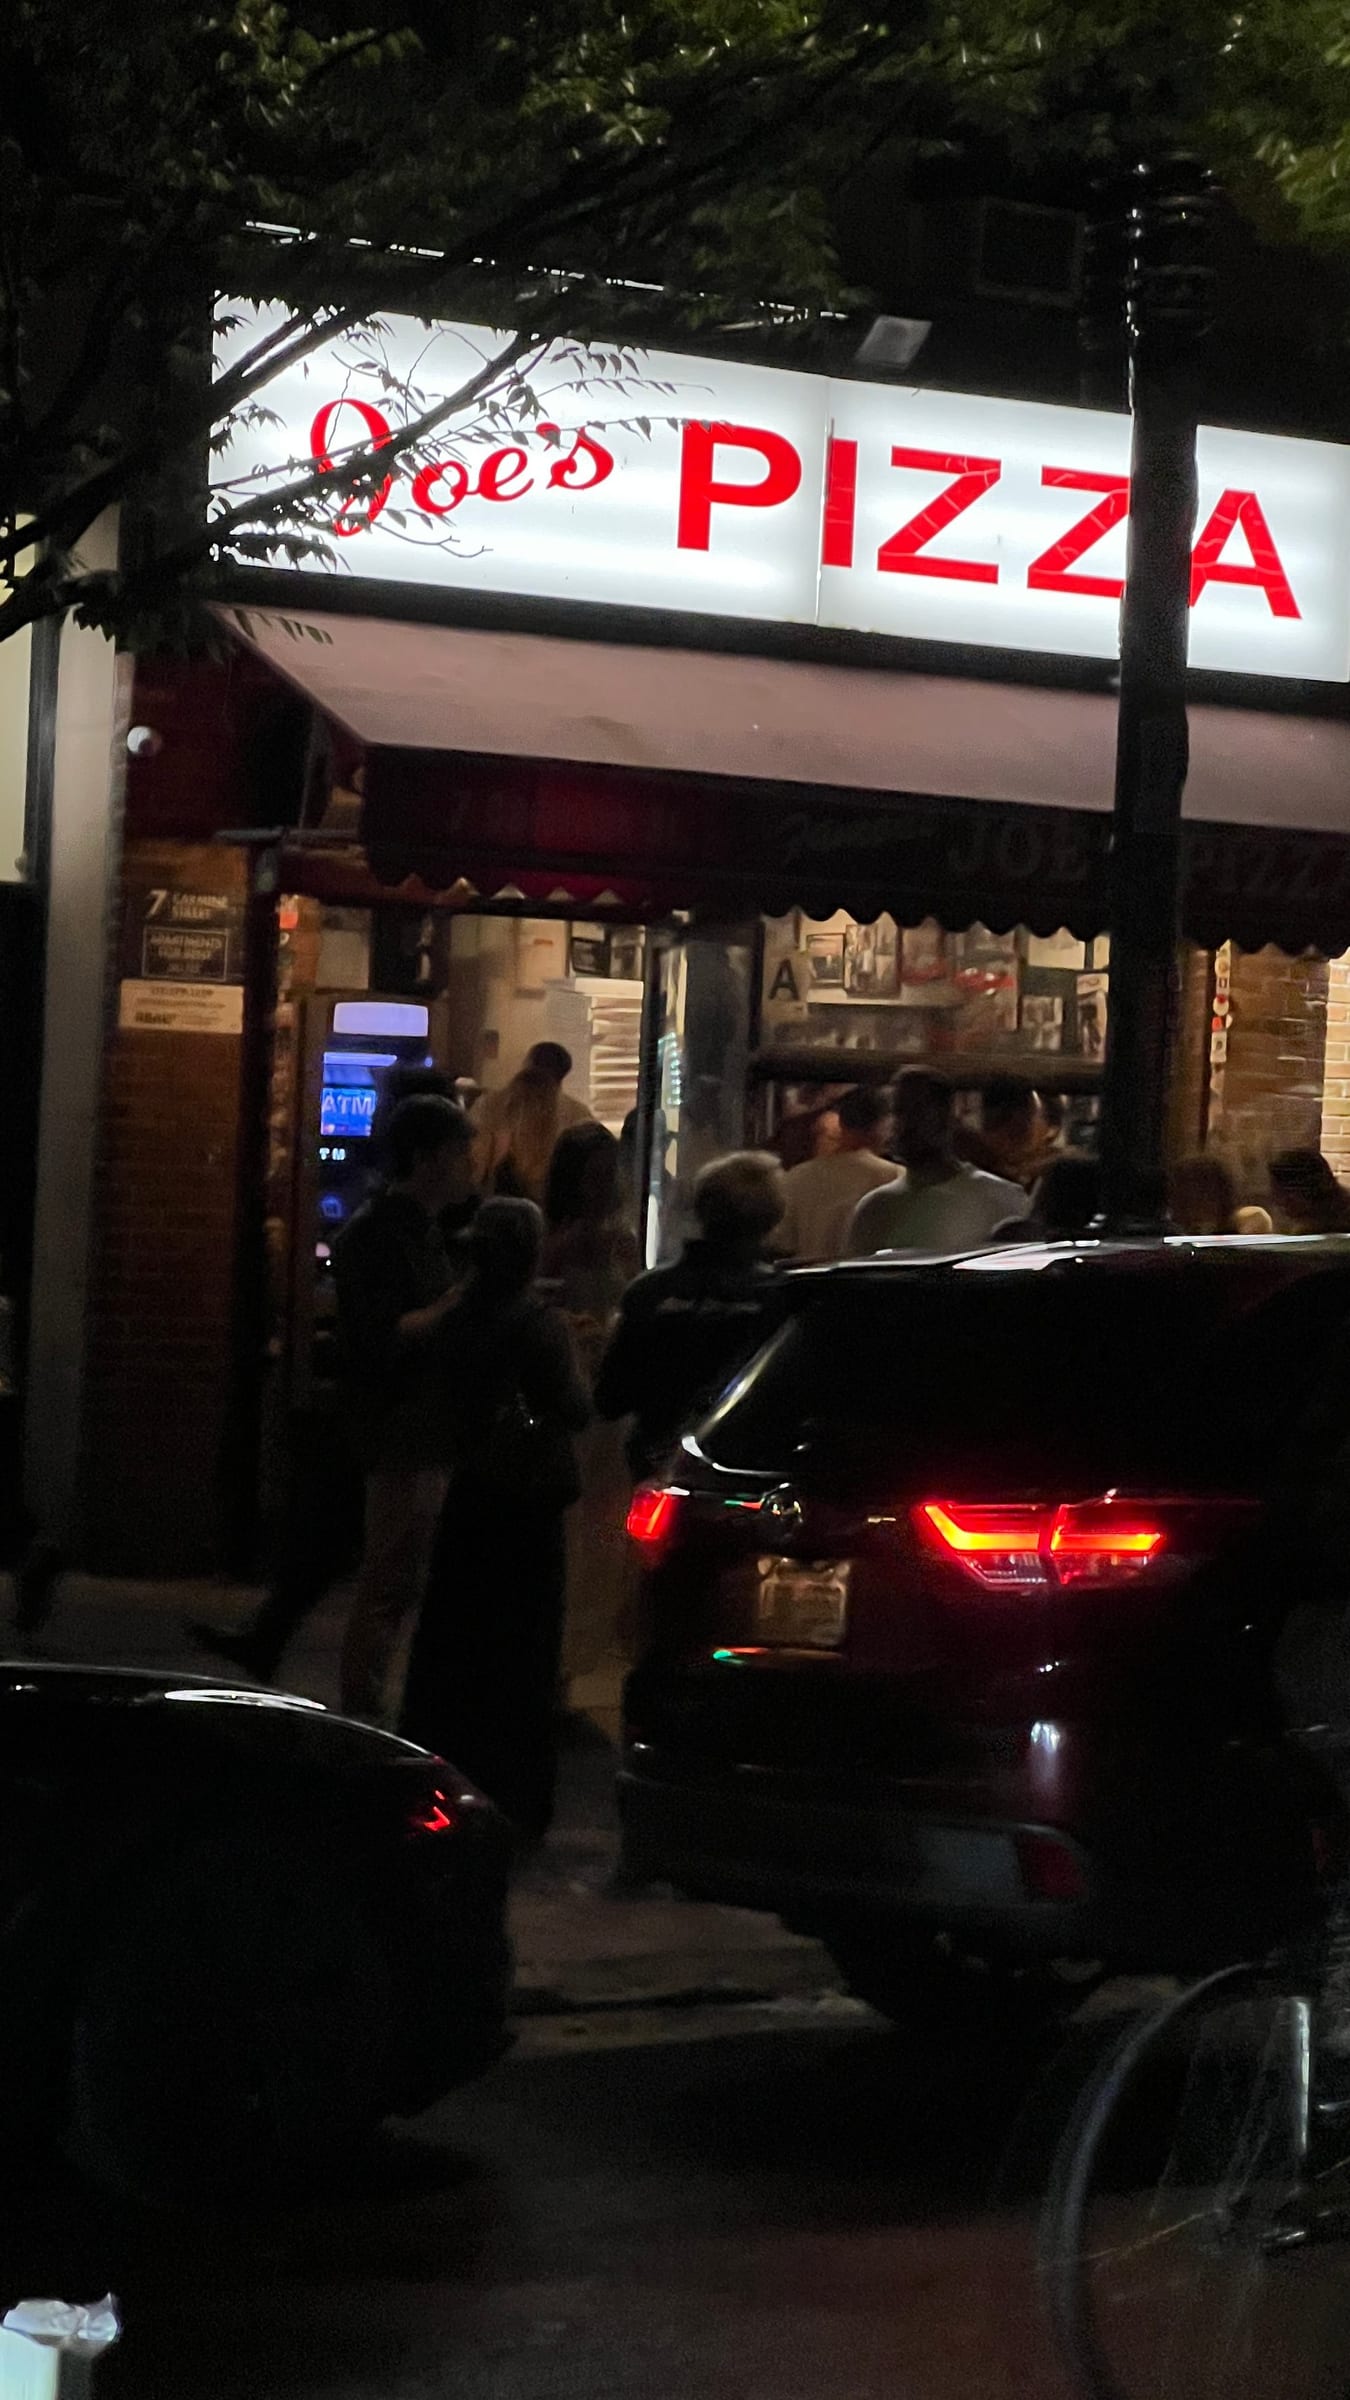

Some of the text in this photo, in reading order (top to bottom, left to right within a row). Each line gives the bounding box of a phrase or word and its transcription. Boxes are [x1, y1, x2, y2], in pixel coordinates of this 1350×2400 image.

[310, 398, 1303, 620] Joe's PIZZA
[146, 888, 167, 919] 7
[322, 1094, 374, 1115] ATM
